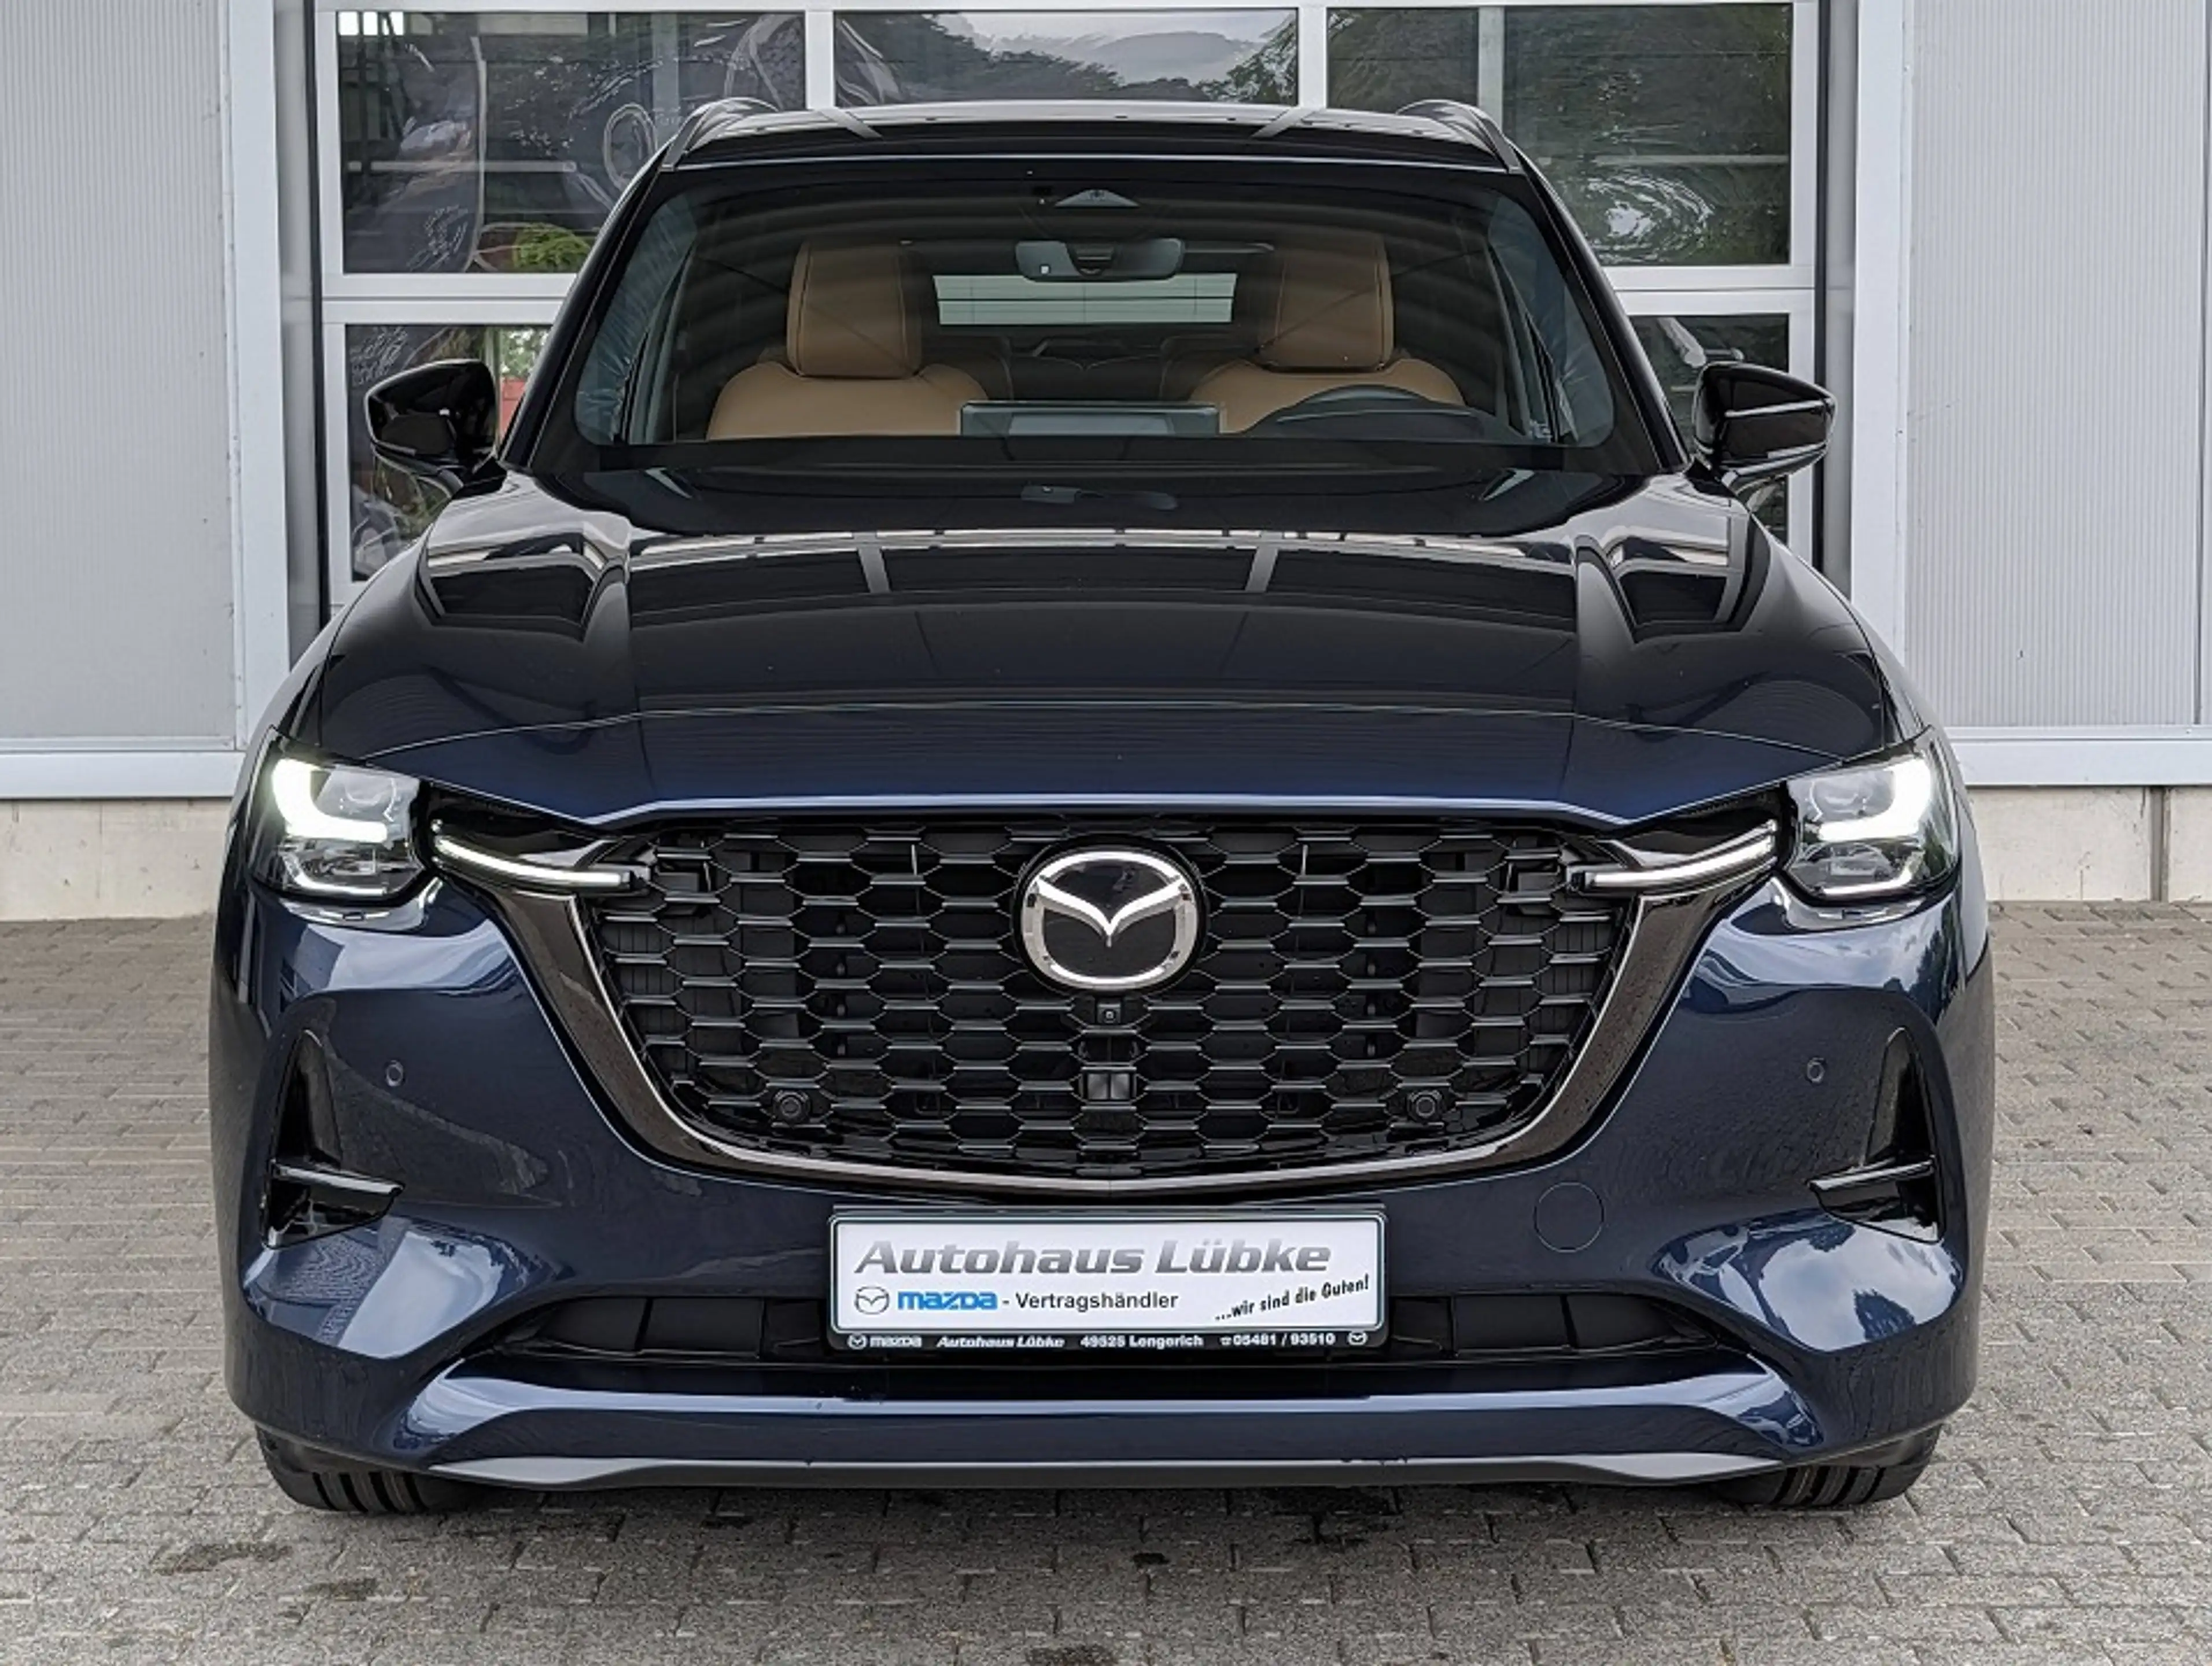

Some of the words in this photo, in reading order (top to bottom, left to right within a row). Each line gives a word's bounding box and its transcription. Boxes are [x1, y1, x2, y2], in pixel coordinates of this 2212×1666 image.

[854, 1240, 1144, 1274] Autohaus
[1155, 1239, 1332, 1273] Lübke
[1016, 1291, 1178, 1313] Vertragshändler
[1260, 1289, 1290, 1311] sind
[1295, 1286, 1316, 1304] die
[1321, 1273, 1369, 1298] Guten!
[937, 1335, 1013, 1348] Autohaus
[1016, 1335, 1066, 1348] Lübke
